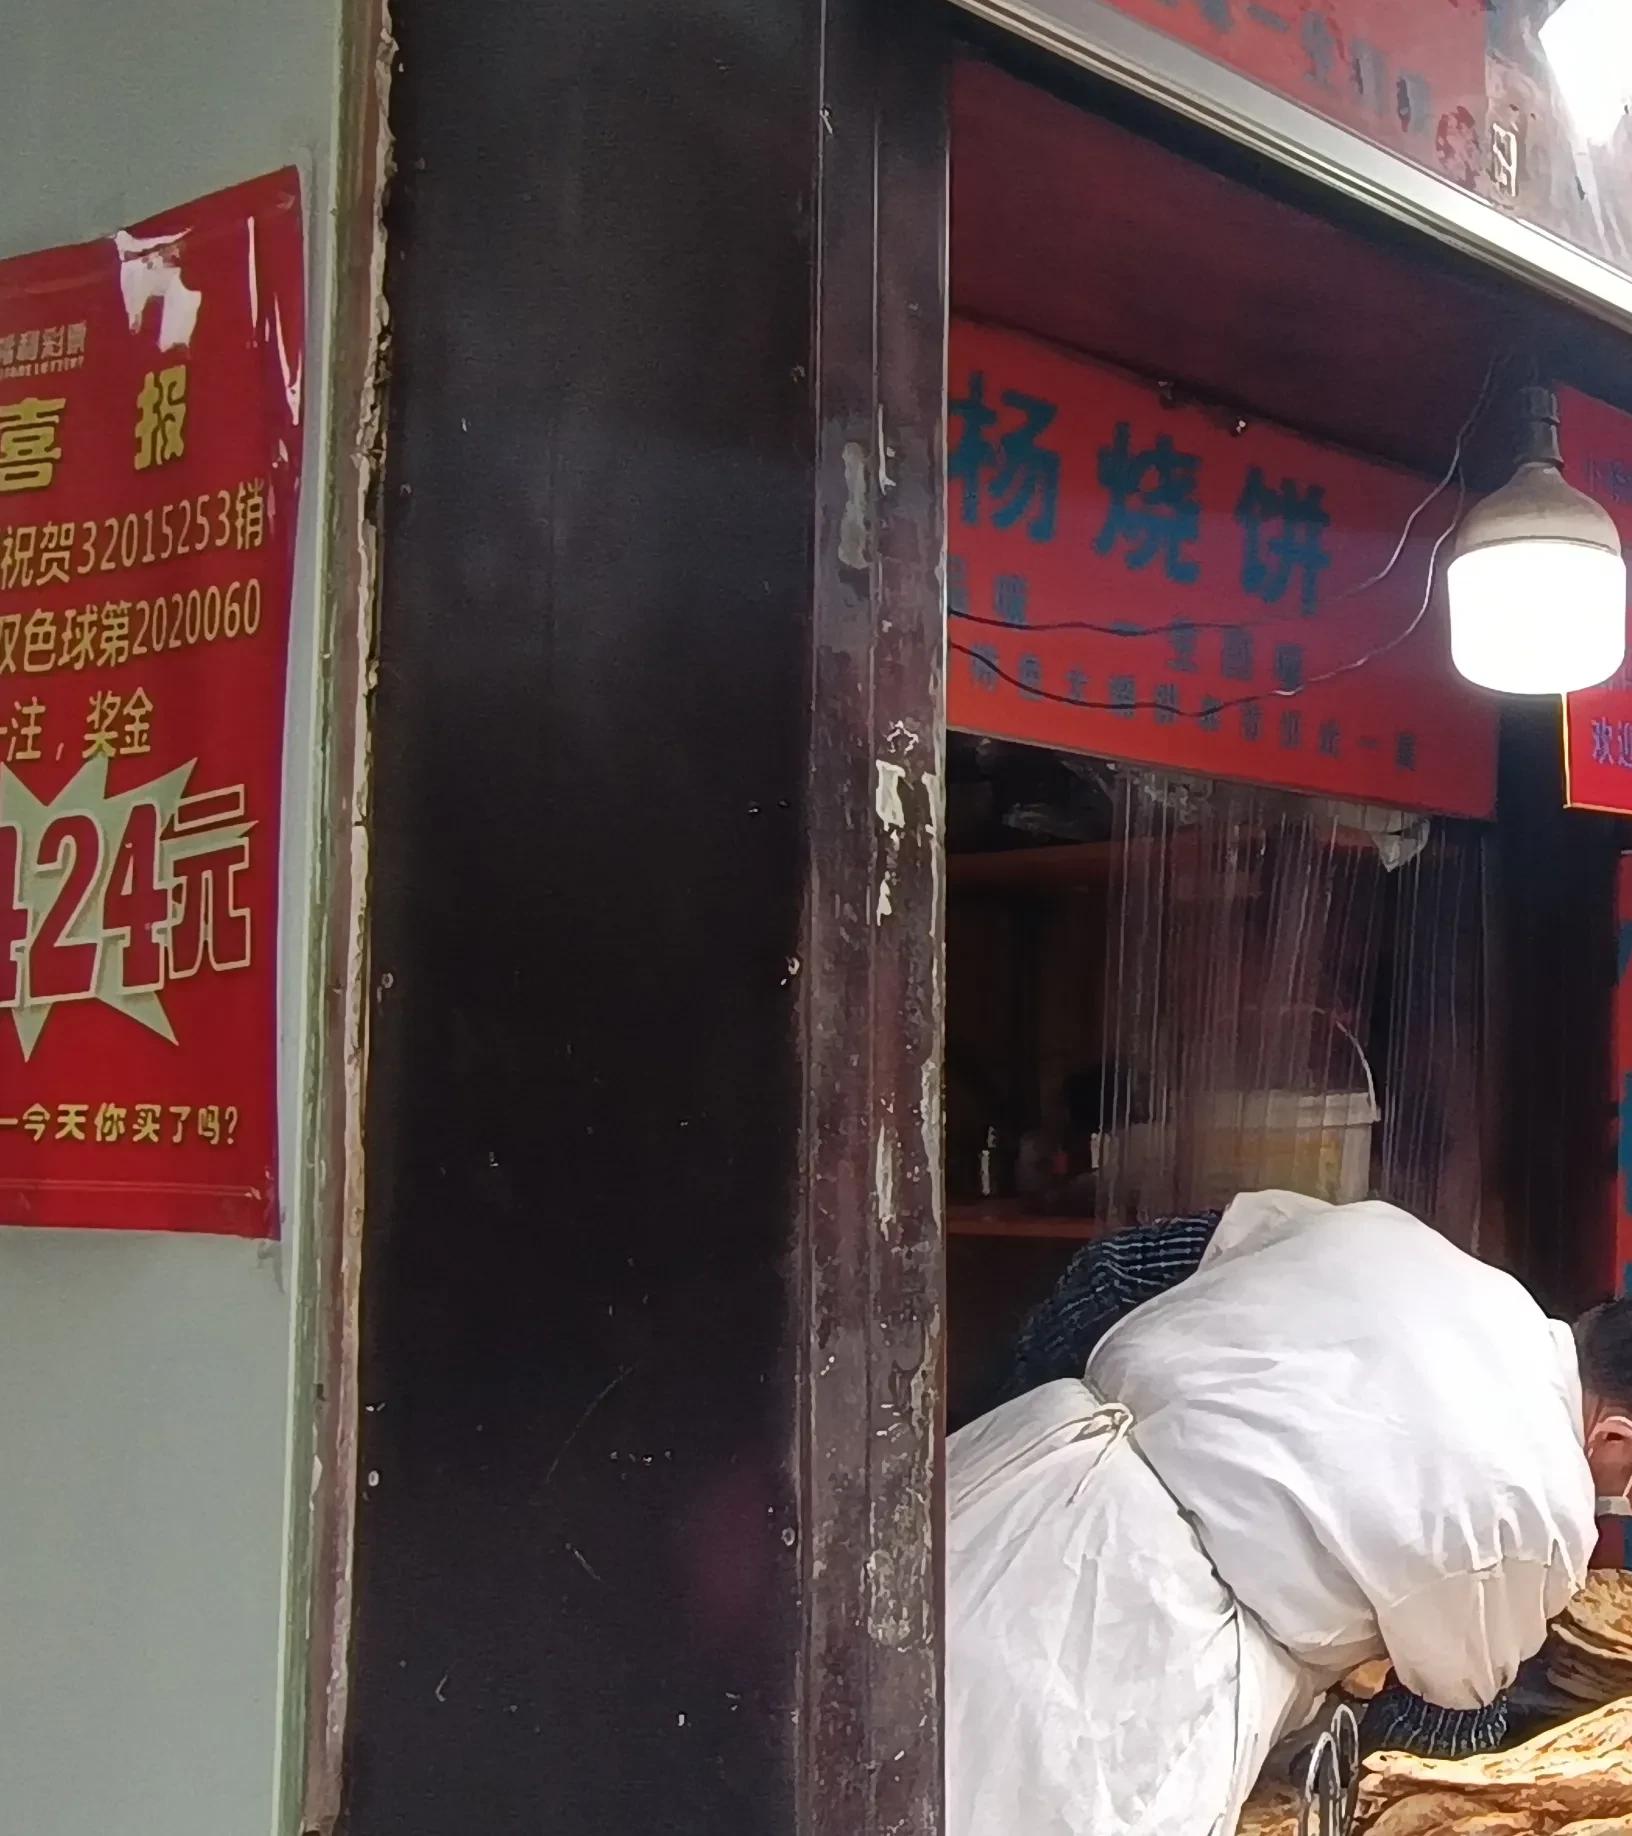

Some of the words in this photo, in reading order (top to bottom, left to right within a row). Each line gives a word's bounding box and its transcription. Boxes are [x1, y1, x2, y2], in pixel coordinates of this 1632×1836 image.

[0, 479, 263, 590] 祝贺32015253销
[948, 371, 1332, 618] 杨烧饼
